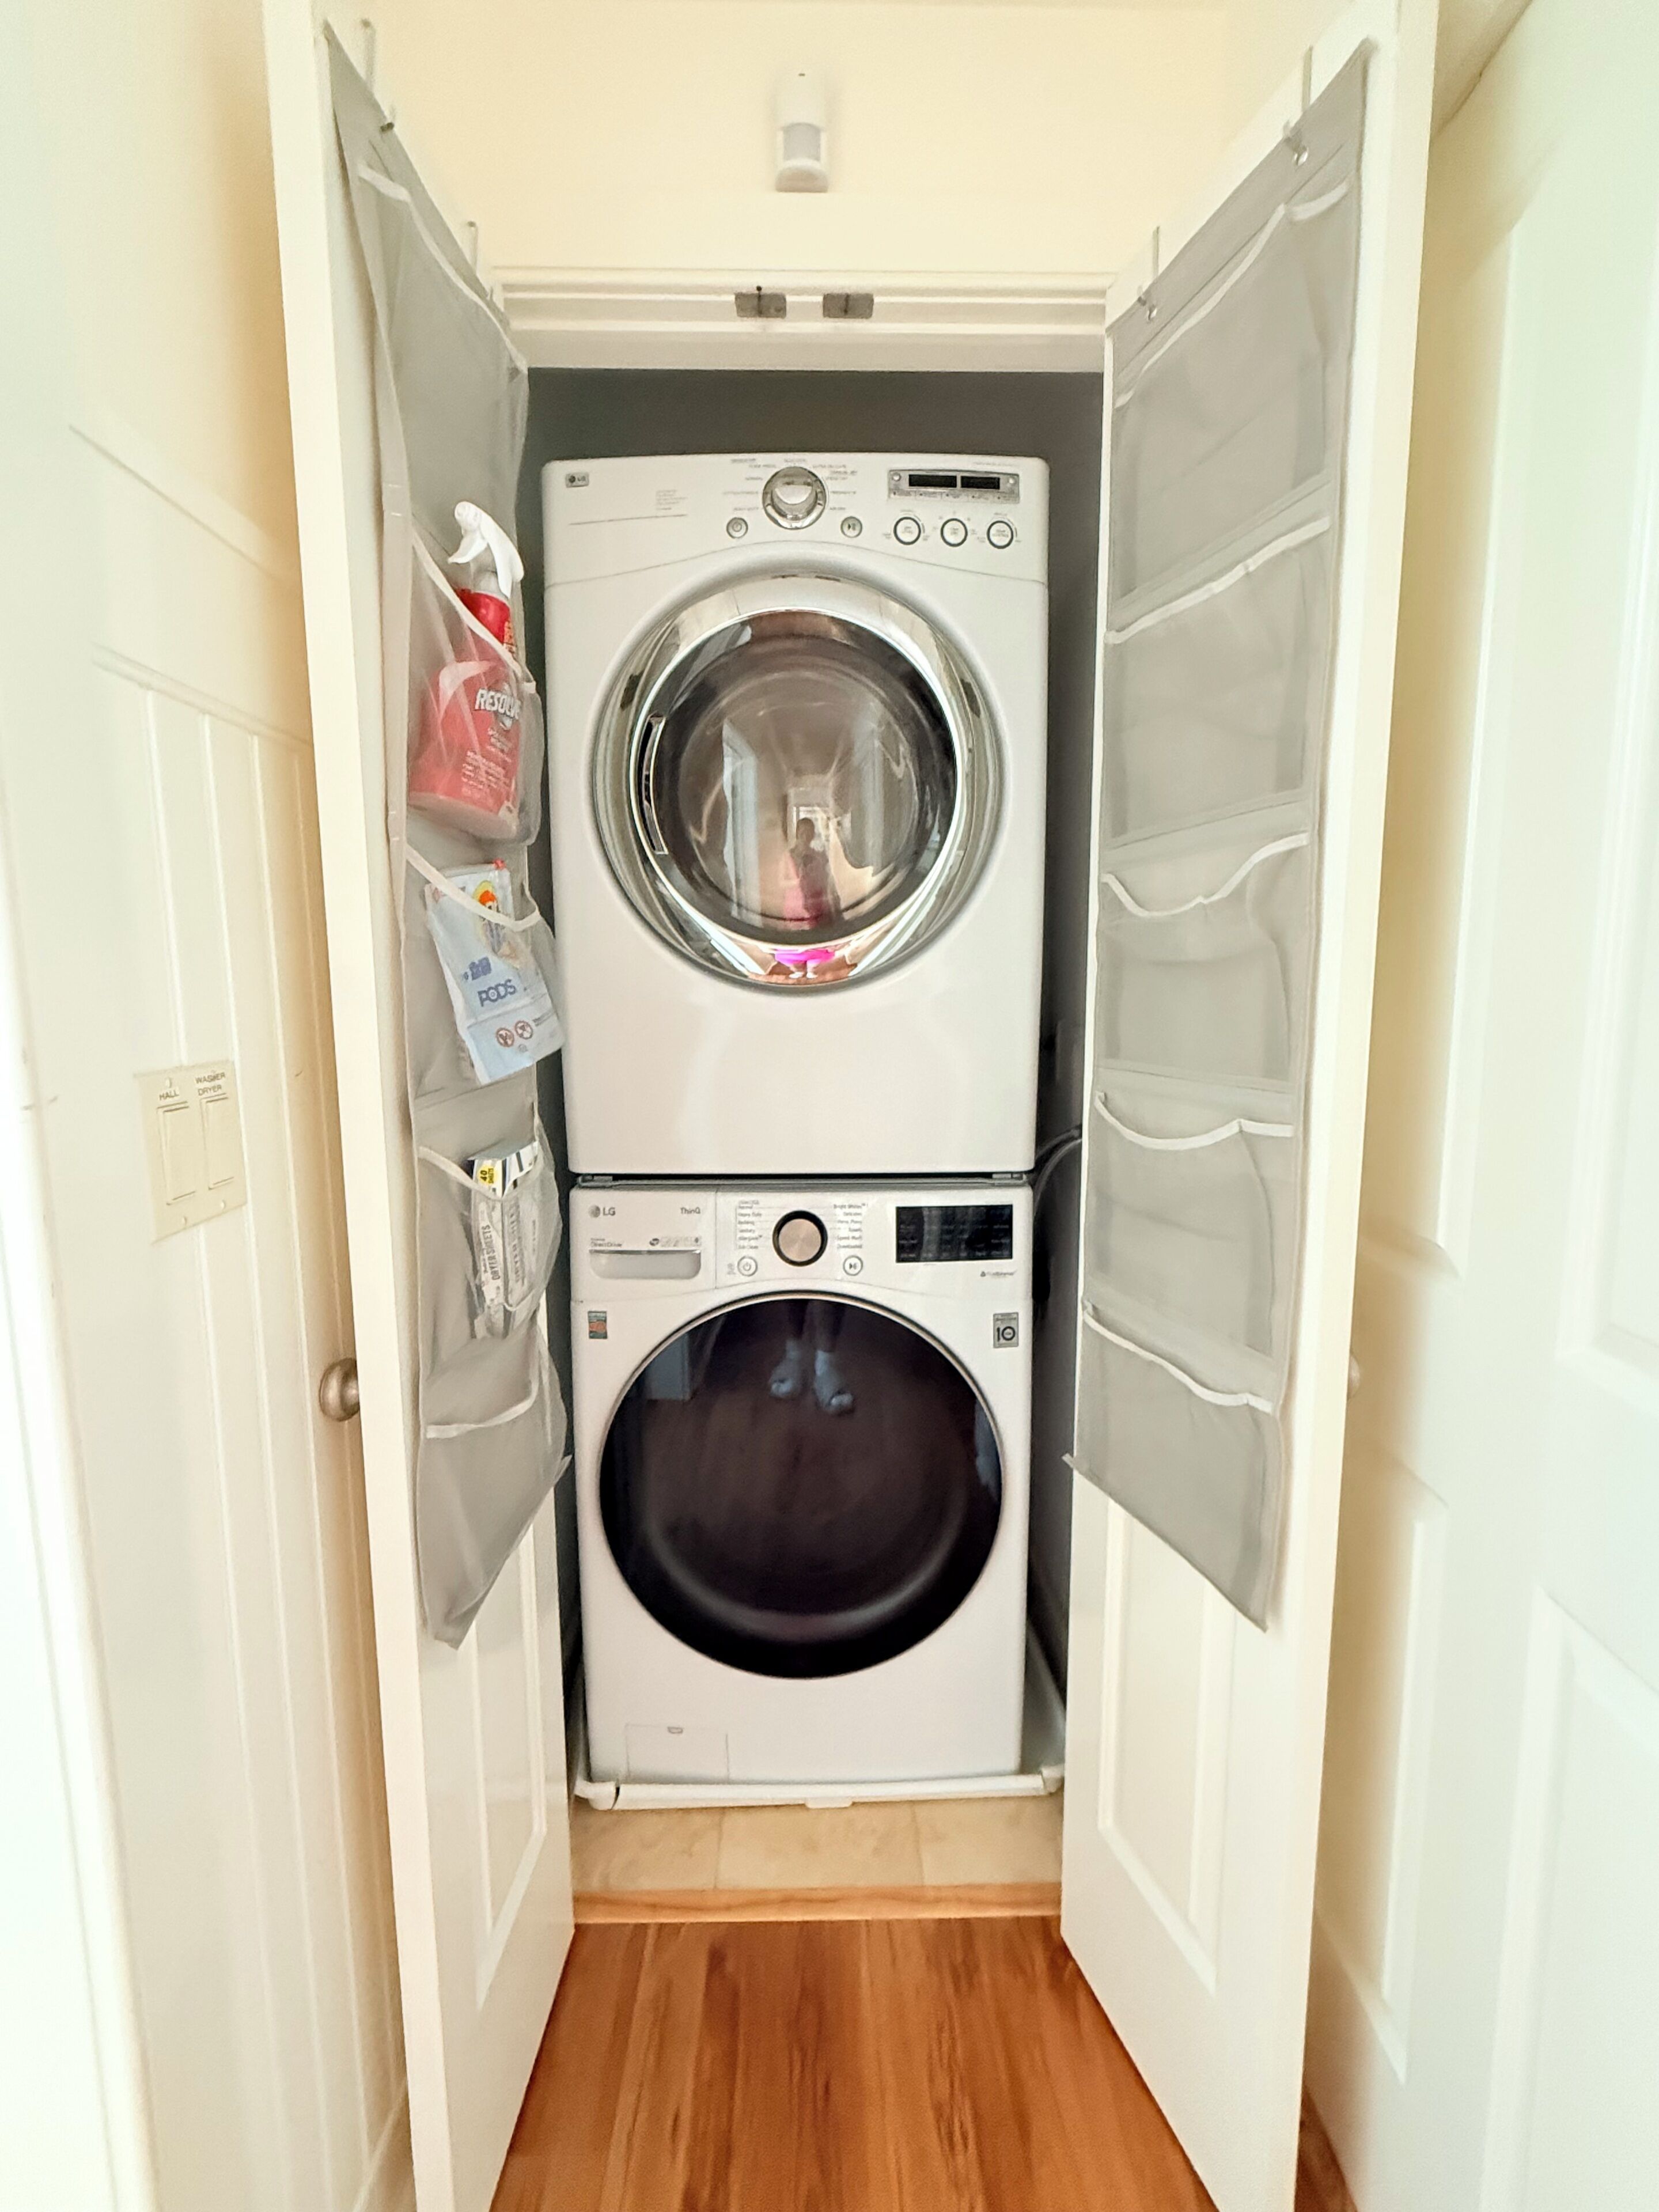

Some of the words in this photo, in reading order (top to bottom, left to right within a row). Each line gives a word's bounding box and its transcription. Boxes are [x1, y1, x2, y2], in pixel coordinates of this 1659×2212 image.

[478, 978, 517, 1007] PODS
[158, 1089, 180, 1101] HALL
[198, 1085, 222, 1096] DRYER
[480, 1170, 487, 1181] 40
[603, 1207, 616, 1216] LG
[997, 1326, 1016, 1342] 10
